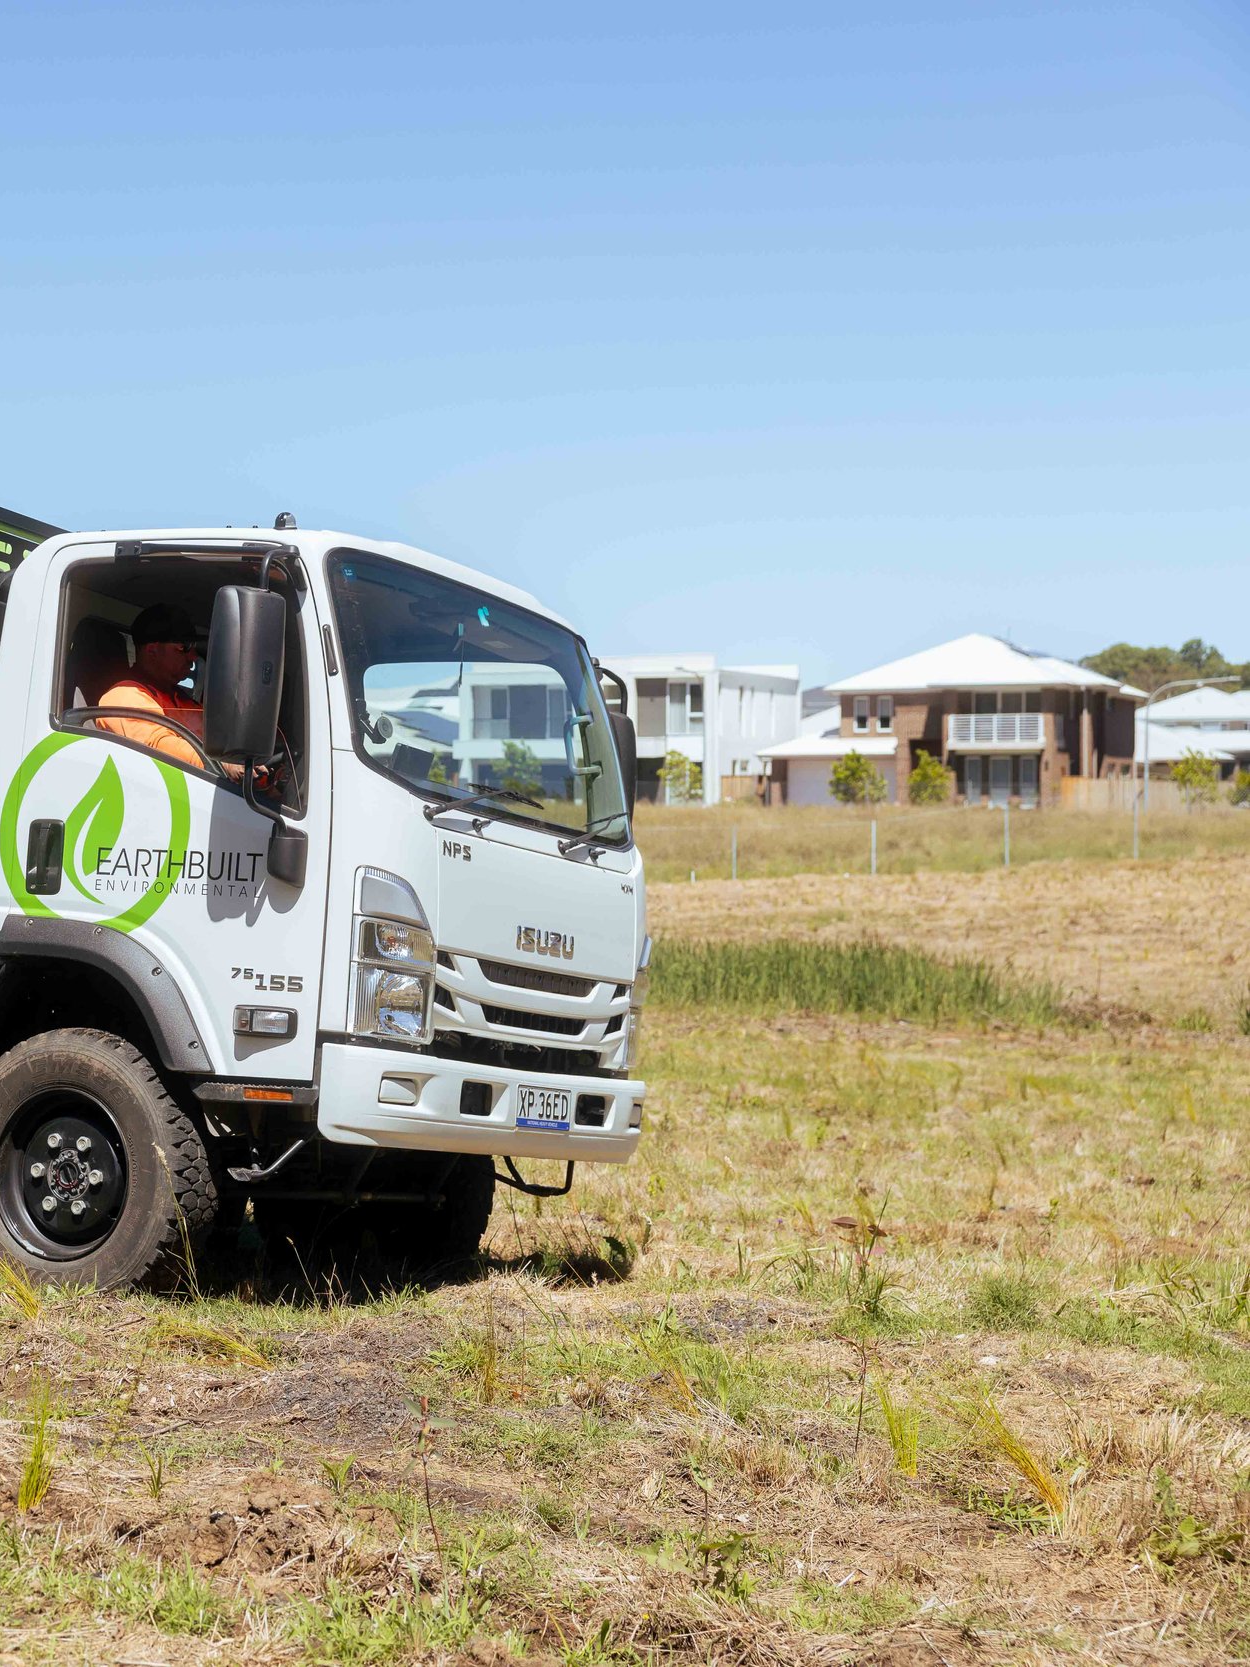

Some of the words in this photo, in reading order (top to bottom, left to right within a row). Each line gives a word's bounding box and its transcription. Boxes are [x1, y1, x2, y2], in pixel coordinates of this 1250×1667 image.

[96, 846, 264, 882] EARTHBUILT
[442, 840, 472, 862] NPS
[95, 879, 262, 899] ENVIRONMENTAL
[516, 925, 575, 960] ISUZU
